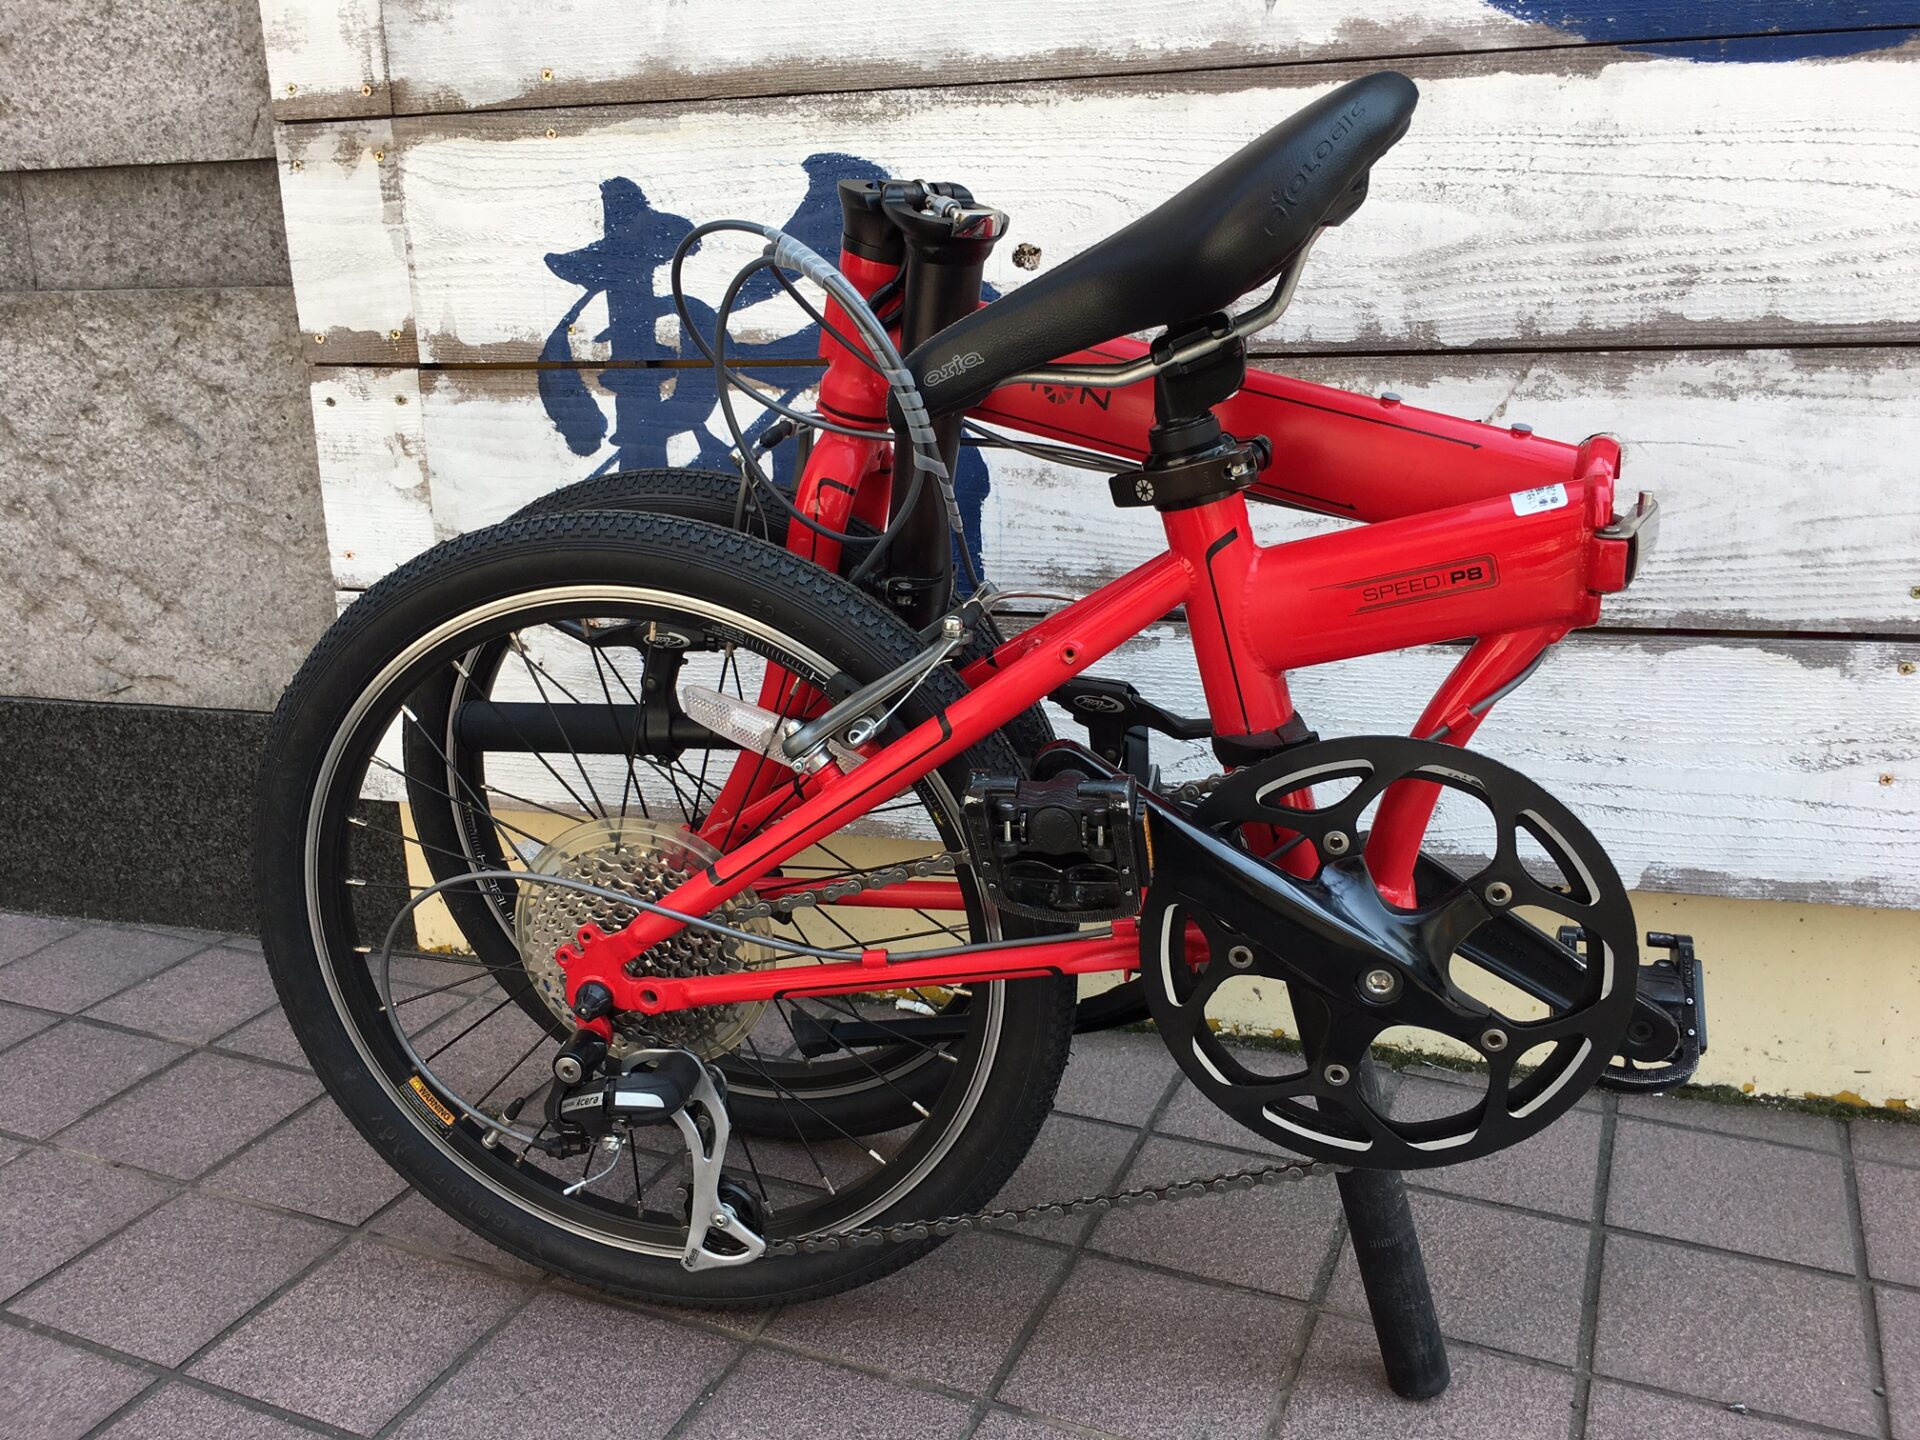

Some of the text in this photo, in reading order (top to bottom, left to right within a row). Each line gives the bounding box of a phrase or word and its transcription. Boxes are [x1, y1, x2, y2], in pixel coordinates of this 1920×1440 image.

[923, 352, 985, 387] aria
[1362, 566, 1483, 602] SPEED P8
[419, 1086, 451, 1121] WARNING
[576, 1096, 599, 1107] Acera
